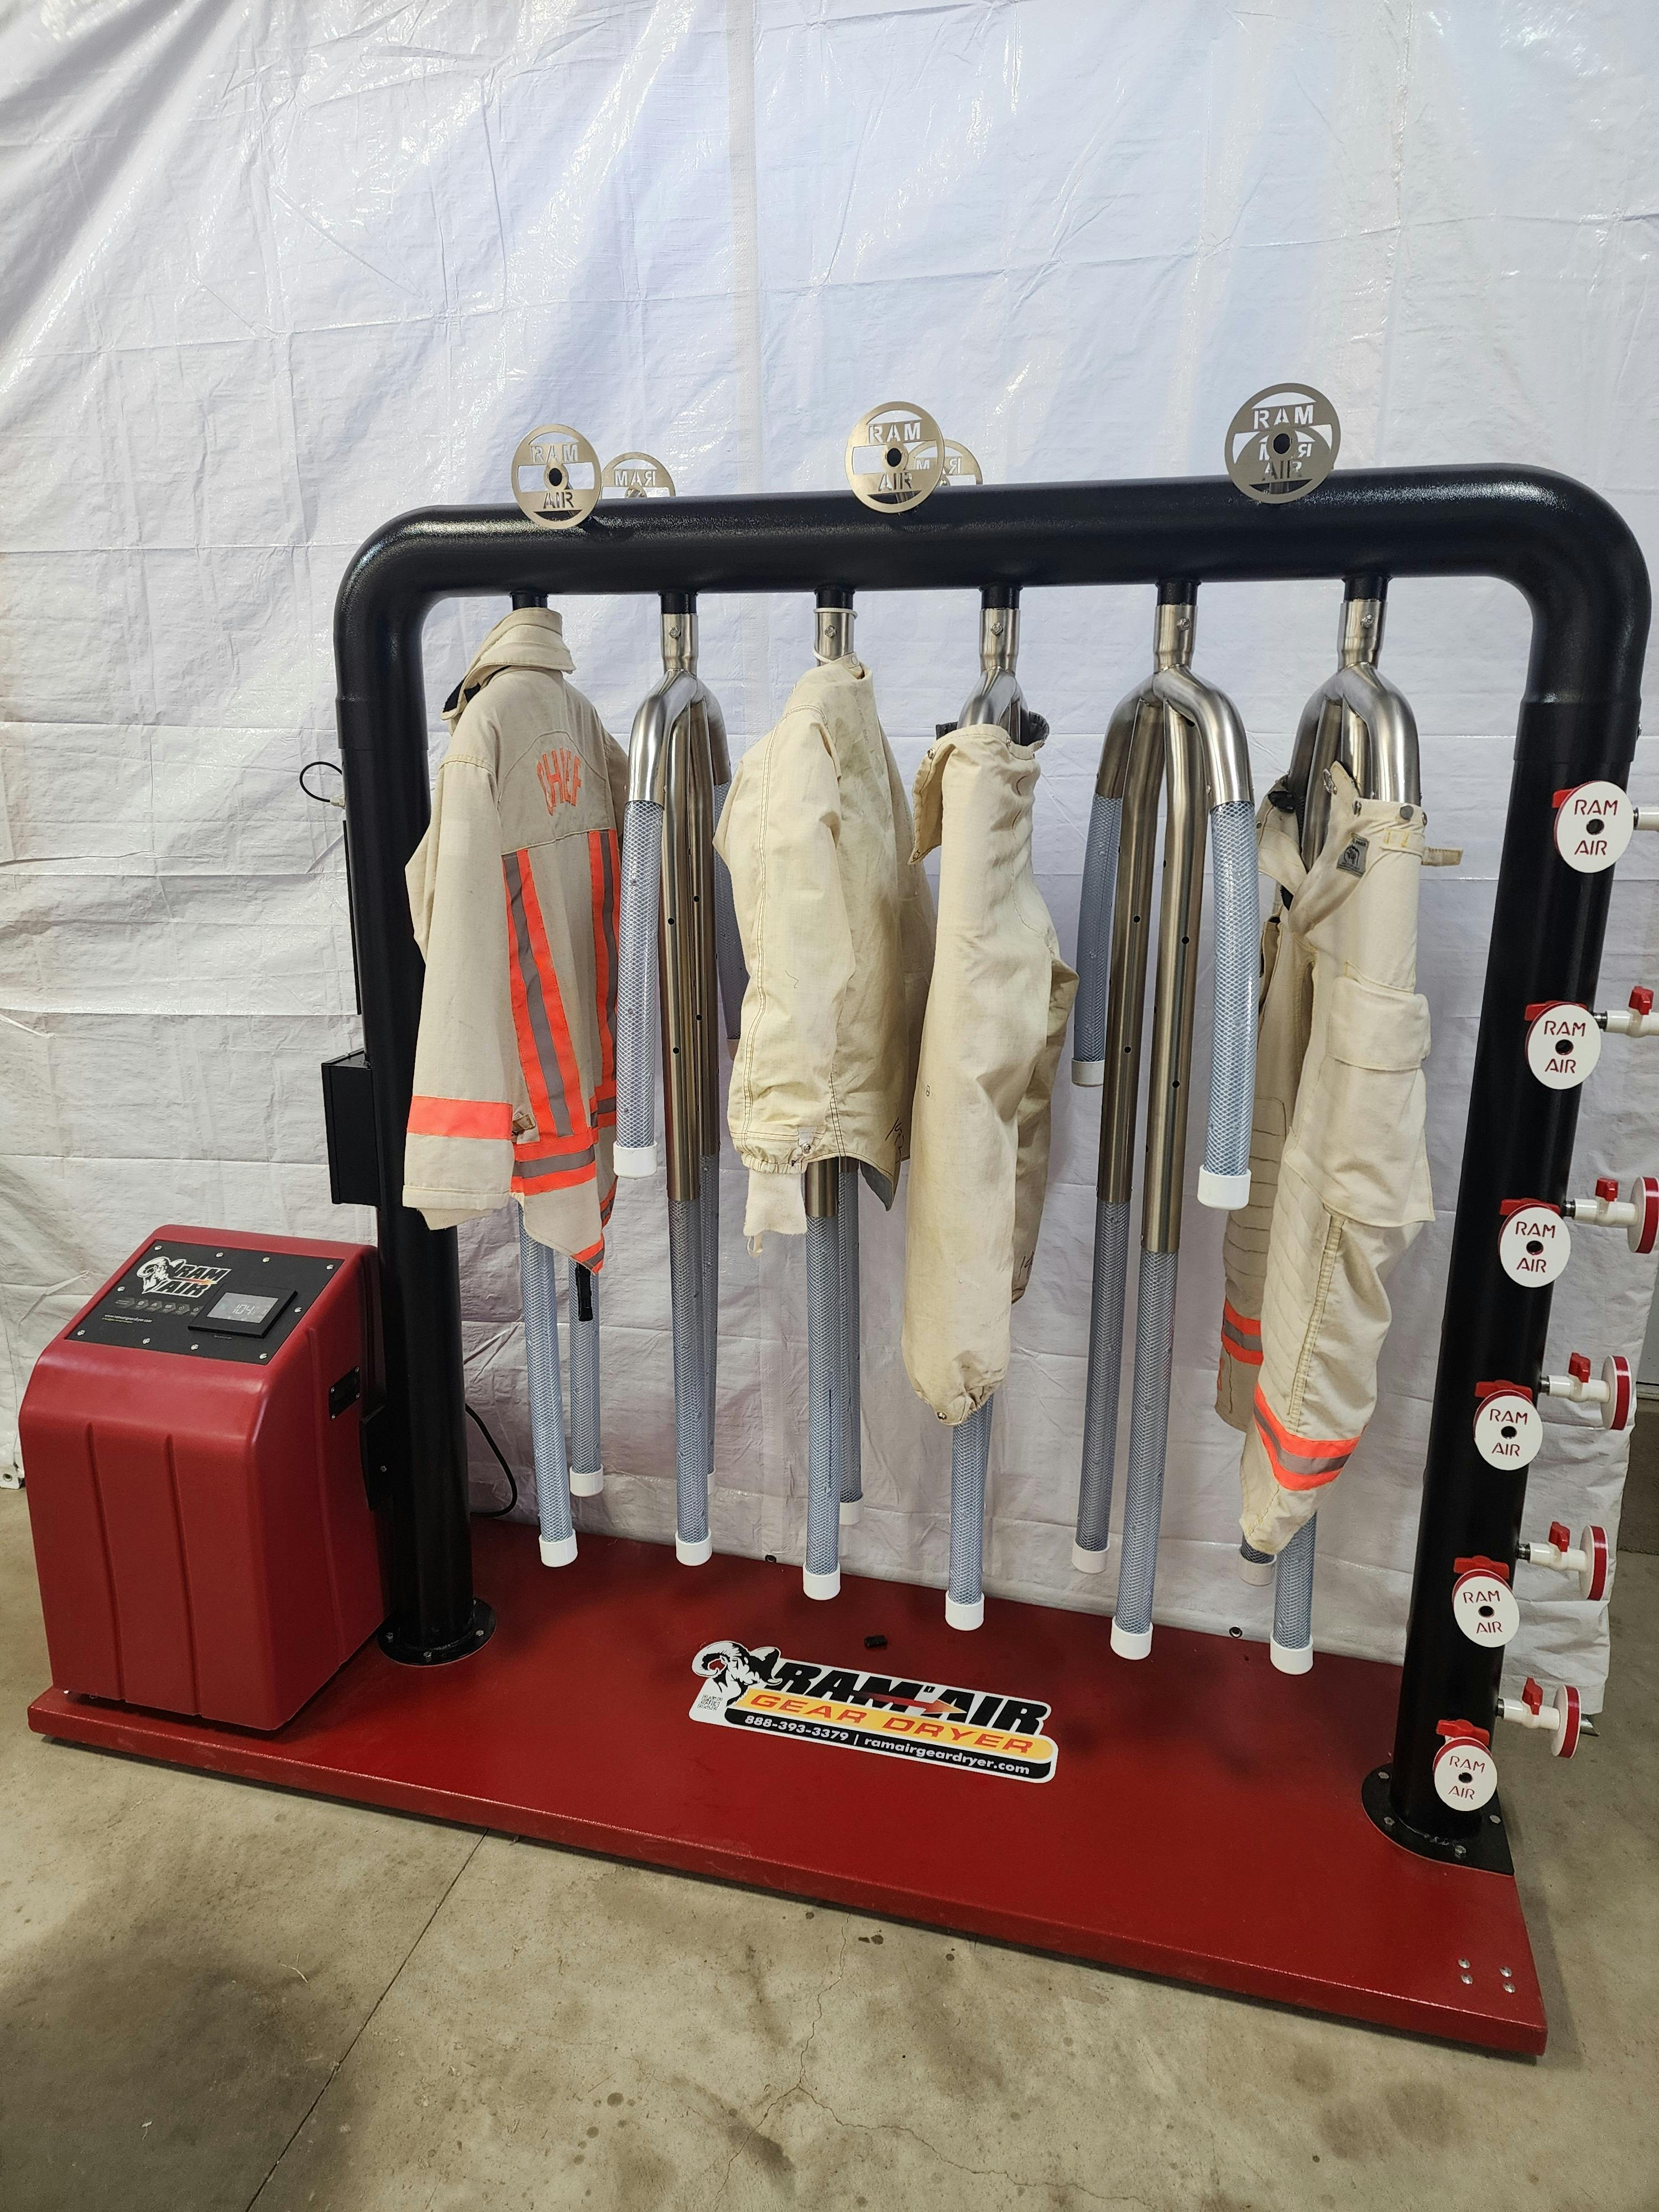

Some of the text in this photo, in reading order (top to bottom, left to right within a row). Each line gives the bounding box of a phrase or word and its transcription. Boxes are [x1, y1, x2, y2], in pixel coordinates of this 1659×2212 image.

[1254, 405, 1314, 430] RAM
[868, 421, 921, 445] RAM
[530, 444, 578, 463] RAM
[1262, 460, 1302, 481] AIR
[878, 472, 913, 492] AIR
[542, 491, 575, 509] AIR
[536, 748, 582, 816] CHIEF
[1574, 799, 1618, 816] RAM
[1574, 840, 1608, 855] AIR
[1543, 1020, 1586, 1037] RAM
[1545, 1058, 1577, 1073] AIR
[1515, 1221, 1556, 1238] RAM
[173, 1264, 232, 1282] RAM
[1516, 1258, 1547, 1273] AIR
[150, 1280, 211, 1298] AIR
[232, 1304, 255, 1315] 104
[1489, 1408, 1528, 1425] RAM
[1491, 1442, 1520, 1457] AIR
[1463, 1590, 1500, 1604] RAM
[1476, 1621, 1503, 1634] AIR
[750, 1694, 1033, 1753] GEAR DRYER
[745, 1715, 849, 1741] 888-393-3379
[864, 1738, 1030, 1775] ramairgeardryer.com
[1449, 1755, 1485, 1773] RAM
[1448, 1786, 1475, 1800] AIR
